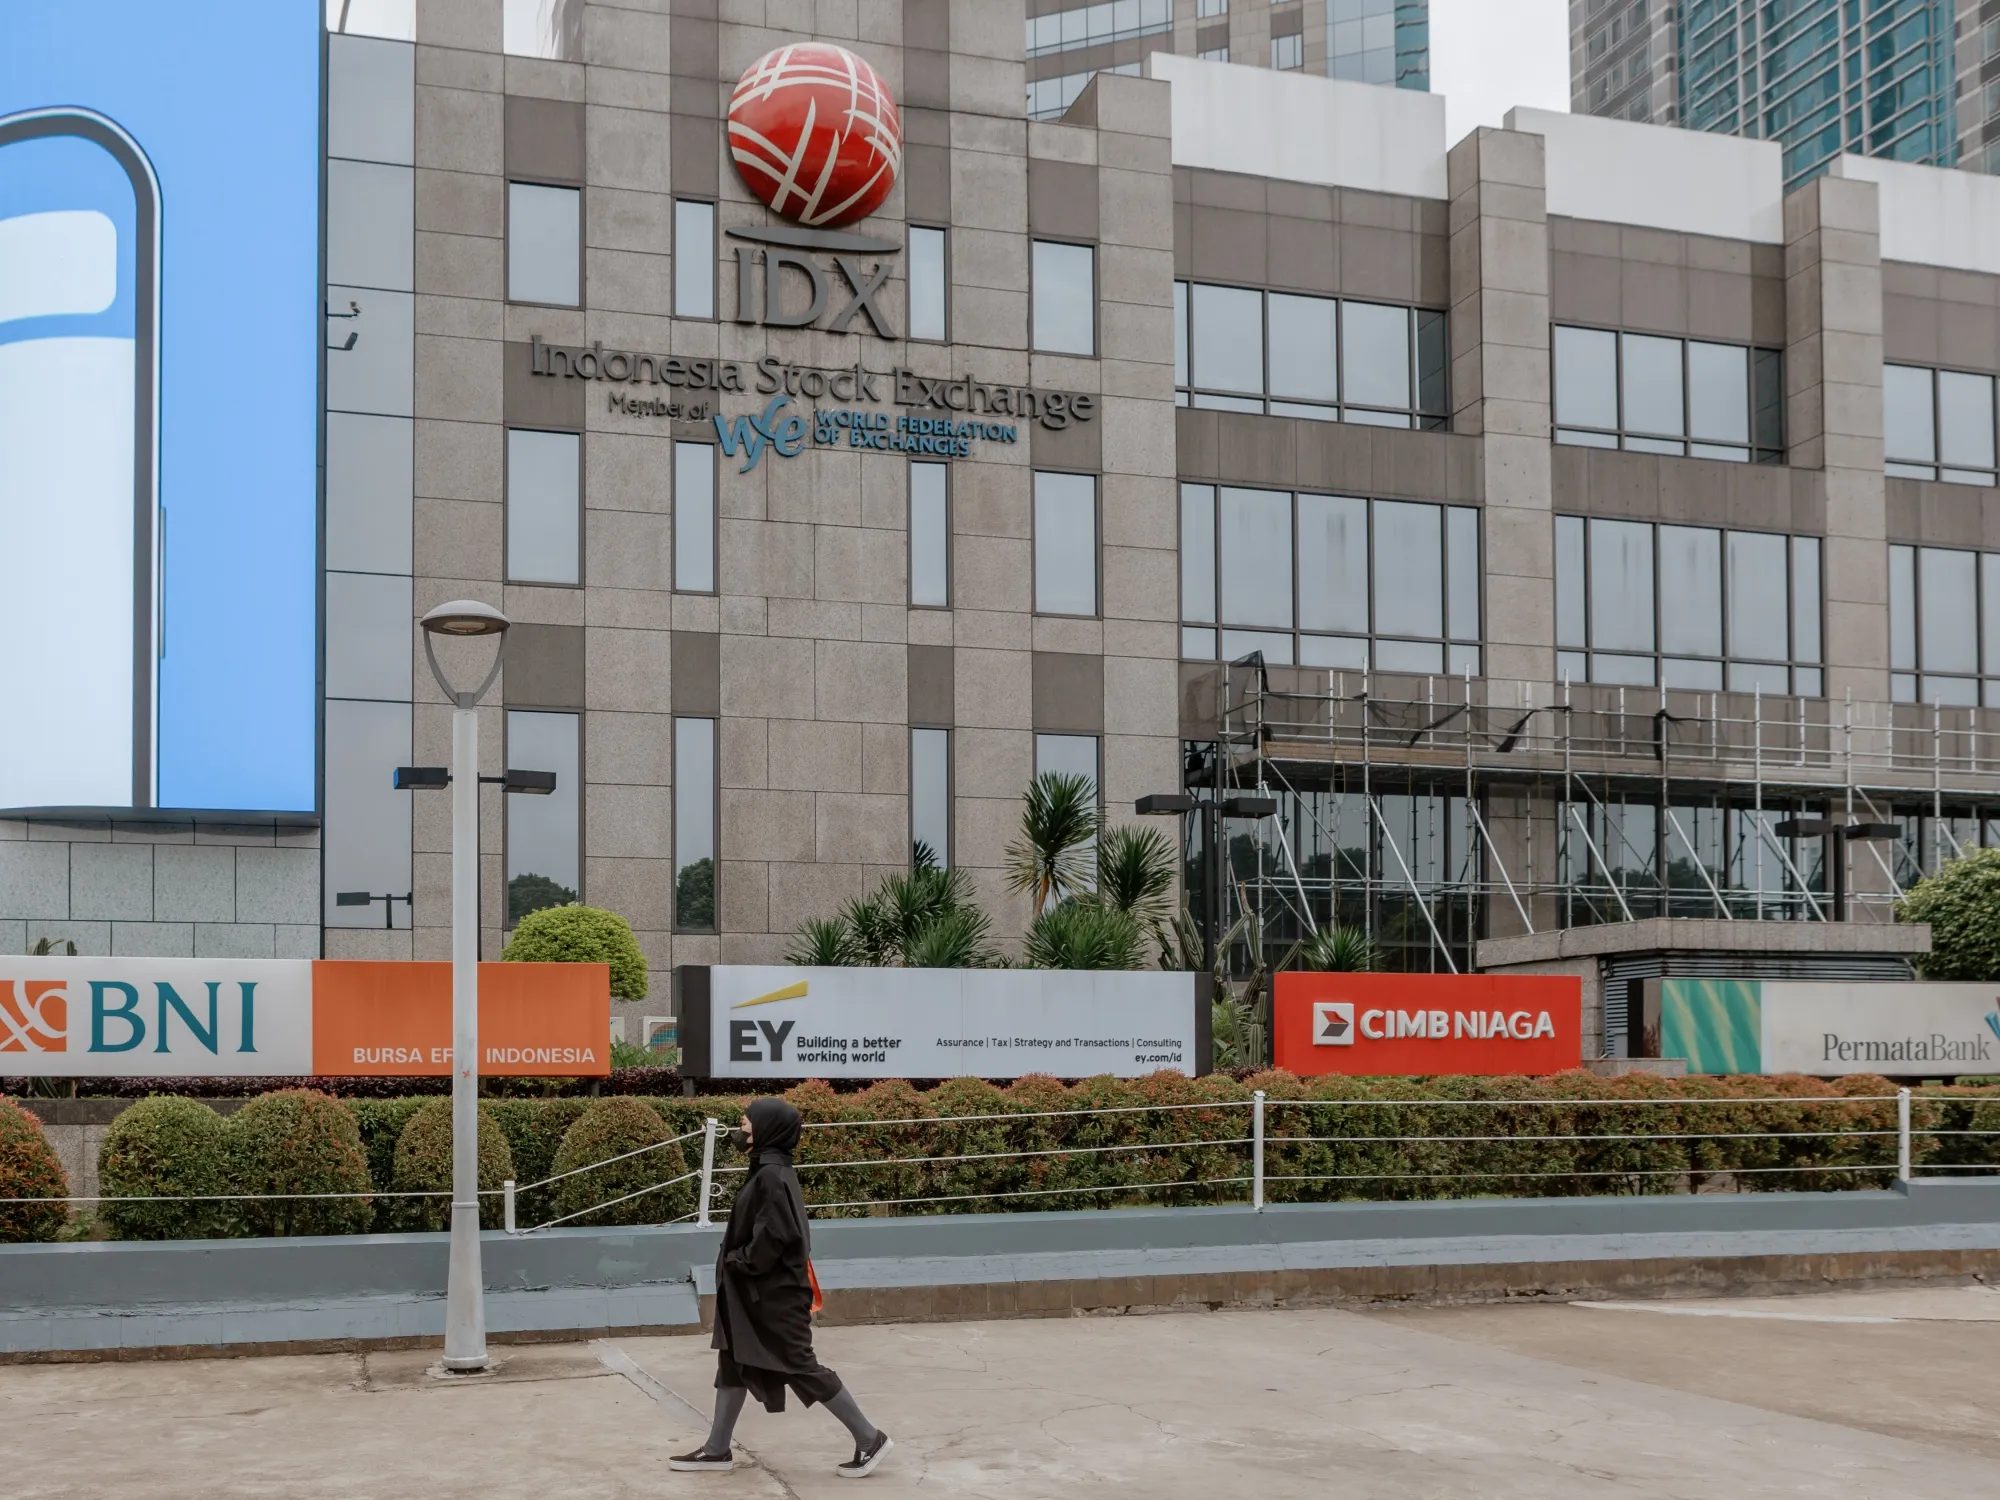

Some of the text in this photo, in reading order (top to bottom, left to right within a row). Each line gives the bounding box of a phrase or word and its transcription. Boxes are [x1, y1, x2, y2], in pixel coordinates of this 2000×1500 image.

[733, 246, 899, 339] IDX
[531, 334, 1095, 430] Indonesia Stock Exchange
[608, 391, 709, 420] Member of
[815, 408, 1018, 442] WORLD FEDERATION
[814, 427, 970, 457] OF EXCHANGES
[87, 981, 259, 1055] BNI
[1359, 1008, 1556, 1041] CIMB NIAGA
[353, 1047, 423, 1064] BURSA
[486, 1047, 596, 1064] INDONESIA
[729, 1020, 796, 1062] EY
[797, 1036, 902, 1050] Building a better
[936, 1037, 1183, 1049] Assurance Tax Strategy and Transactions Consulting
[1822, 1033, 1992, 1062] PermataBank
[797, 1051, 886, 1064] working world
[1135, 1053, 1183, 1064] ey.com/id
